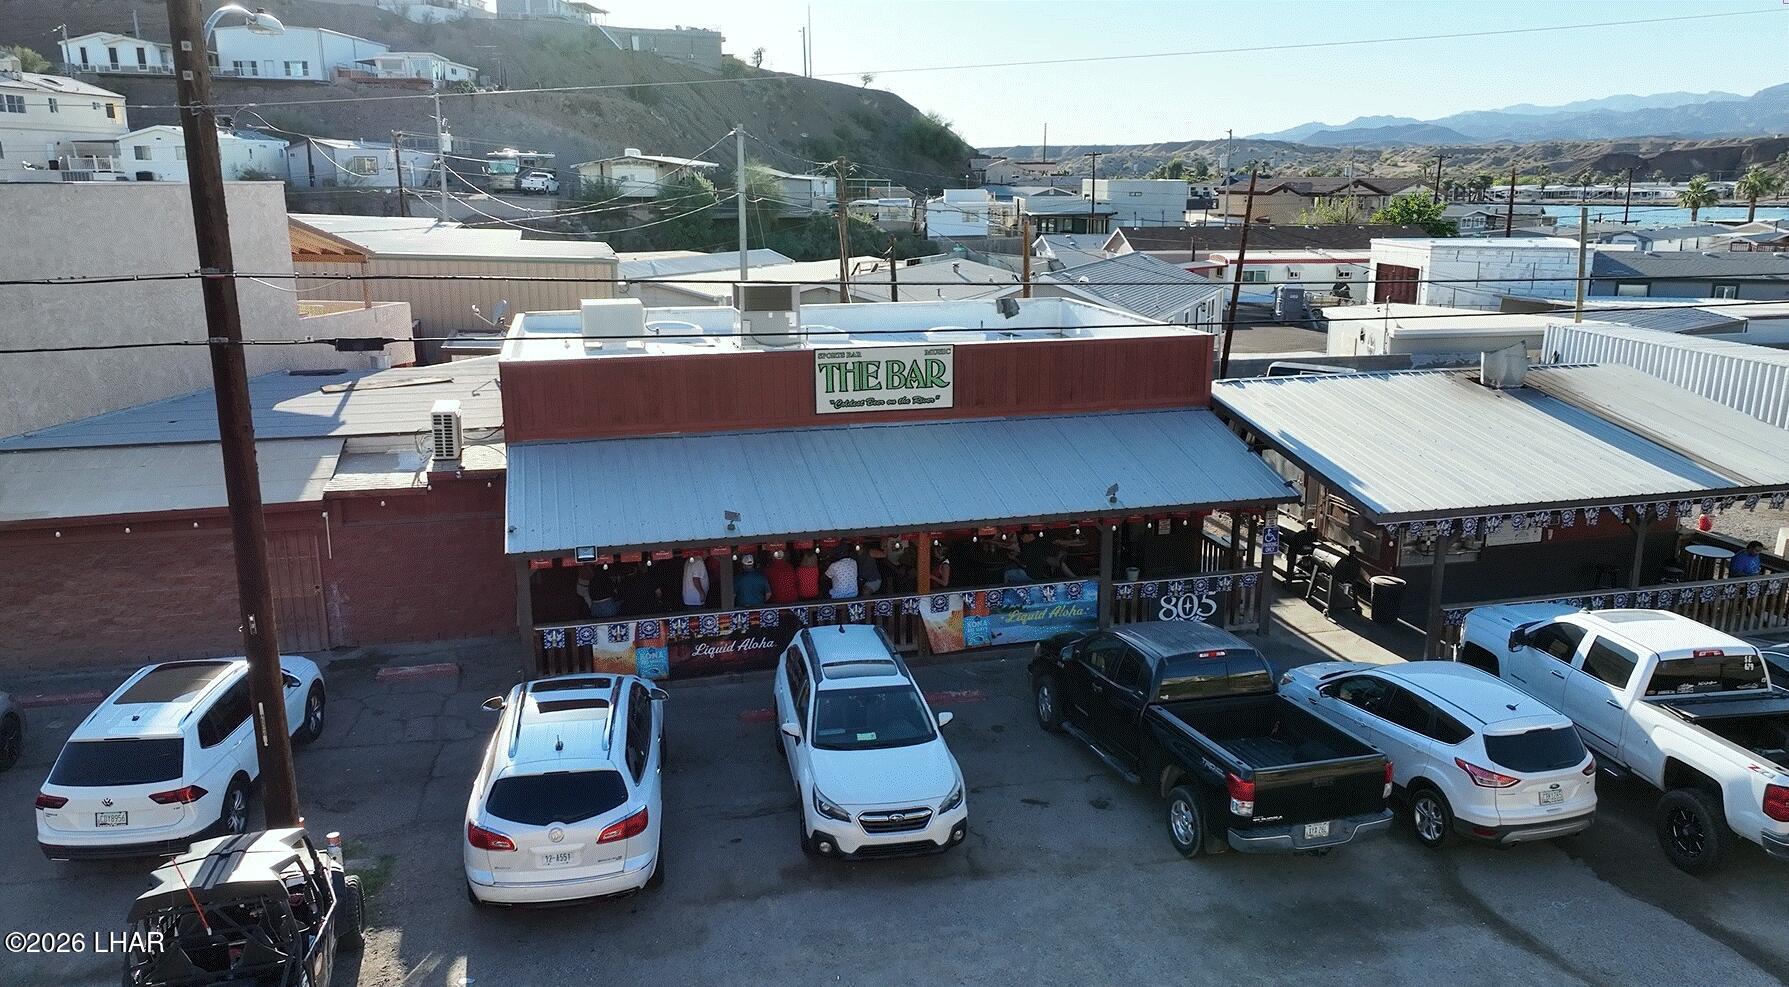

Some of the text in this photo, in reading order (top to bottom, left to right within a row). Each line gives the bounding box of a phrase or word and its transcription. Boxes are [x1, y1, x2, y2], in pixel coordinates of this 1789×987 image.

[817, 351, 862, 360] SPORTS BAR
[924, 348, 951, 356] MUSIC
[817, 358, 950, 394] THE BAR
[865, 397, 885, 406] Beer
[898, 395, 911, 405] the
[1158, 592, 1217, 621] 805
[1005, 608, 1045, 624] Liquid
[691, 637, 775, 658] Liquid Aloha
